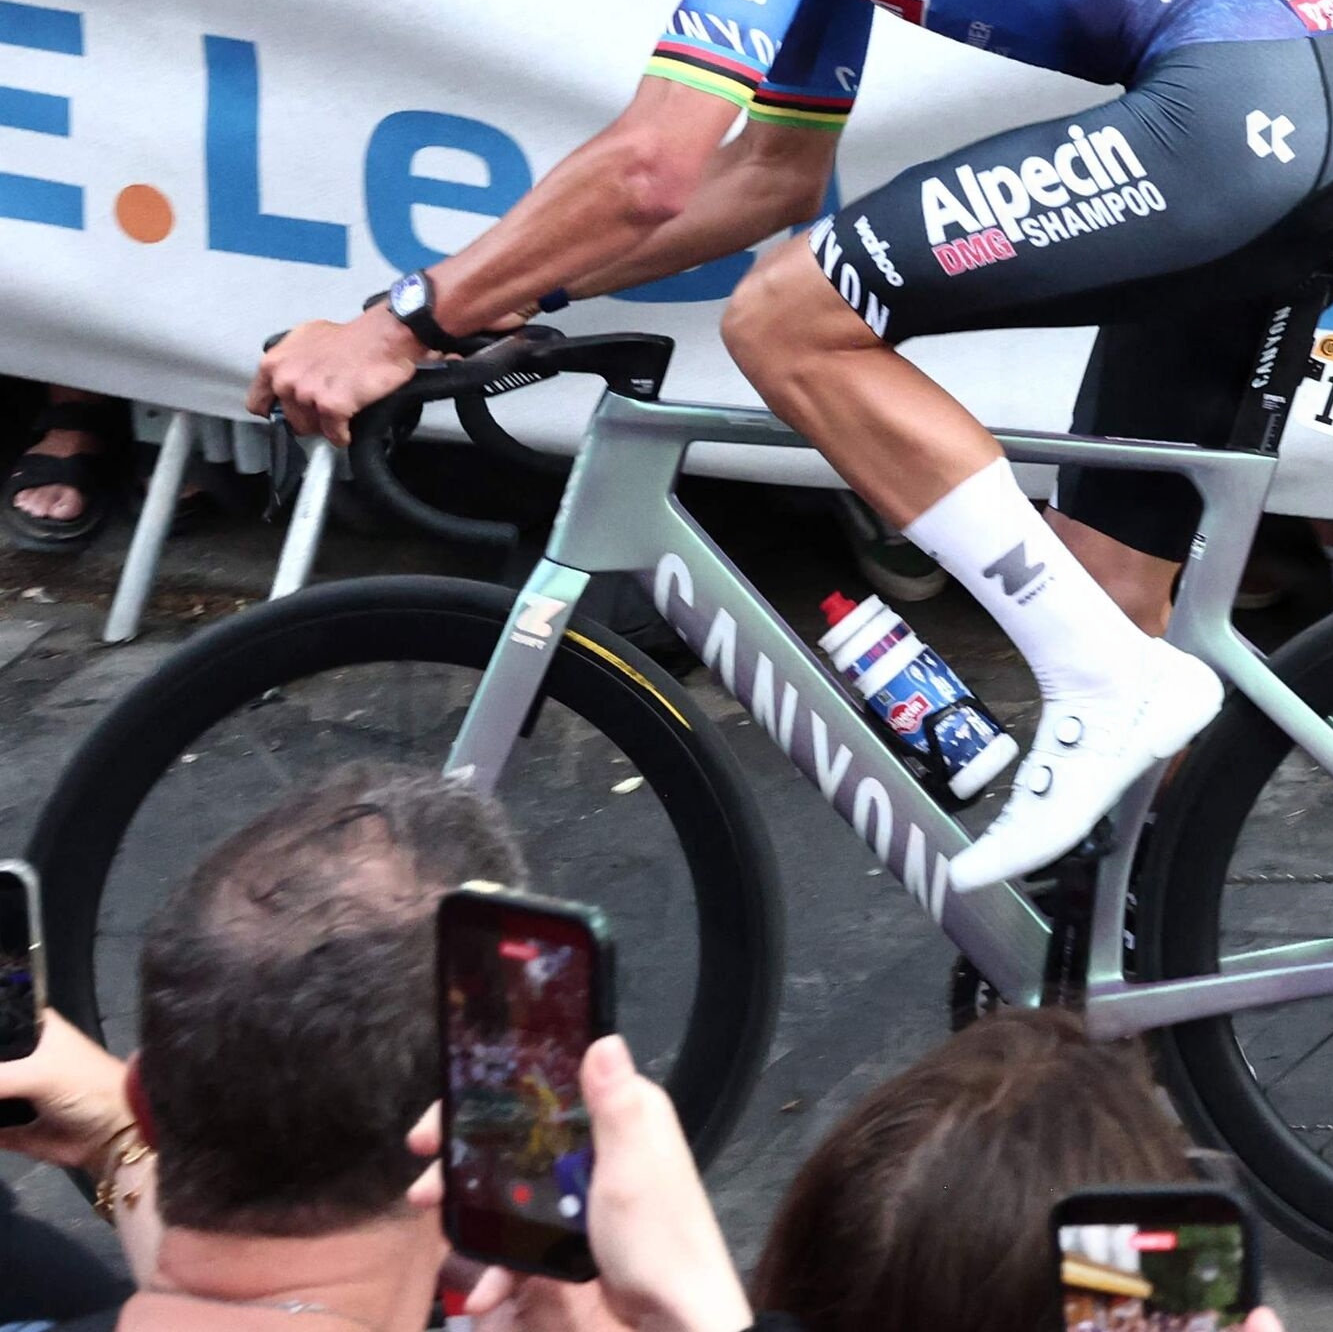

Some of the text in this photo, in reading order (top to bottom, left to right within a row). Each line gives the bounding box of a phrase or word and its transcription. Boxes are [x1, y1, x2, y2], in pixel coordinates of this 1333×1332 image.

[921, 124, 1148, 247] Alpecin
[931, 179, 1168, 277] DMG SHAMPOO
[1251, 305, 1292, 389] CANYON
[654, 552, 951, 926] CANYON
